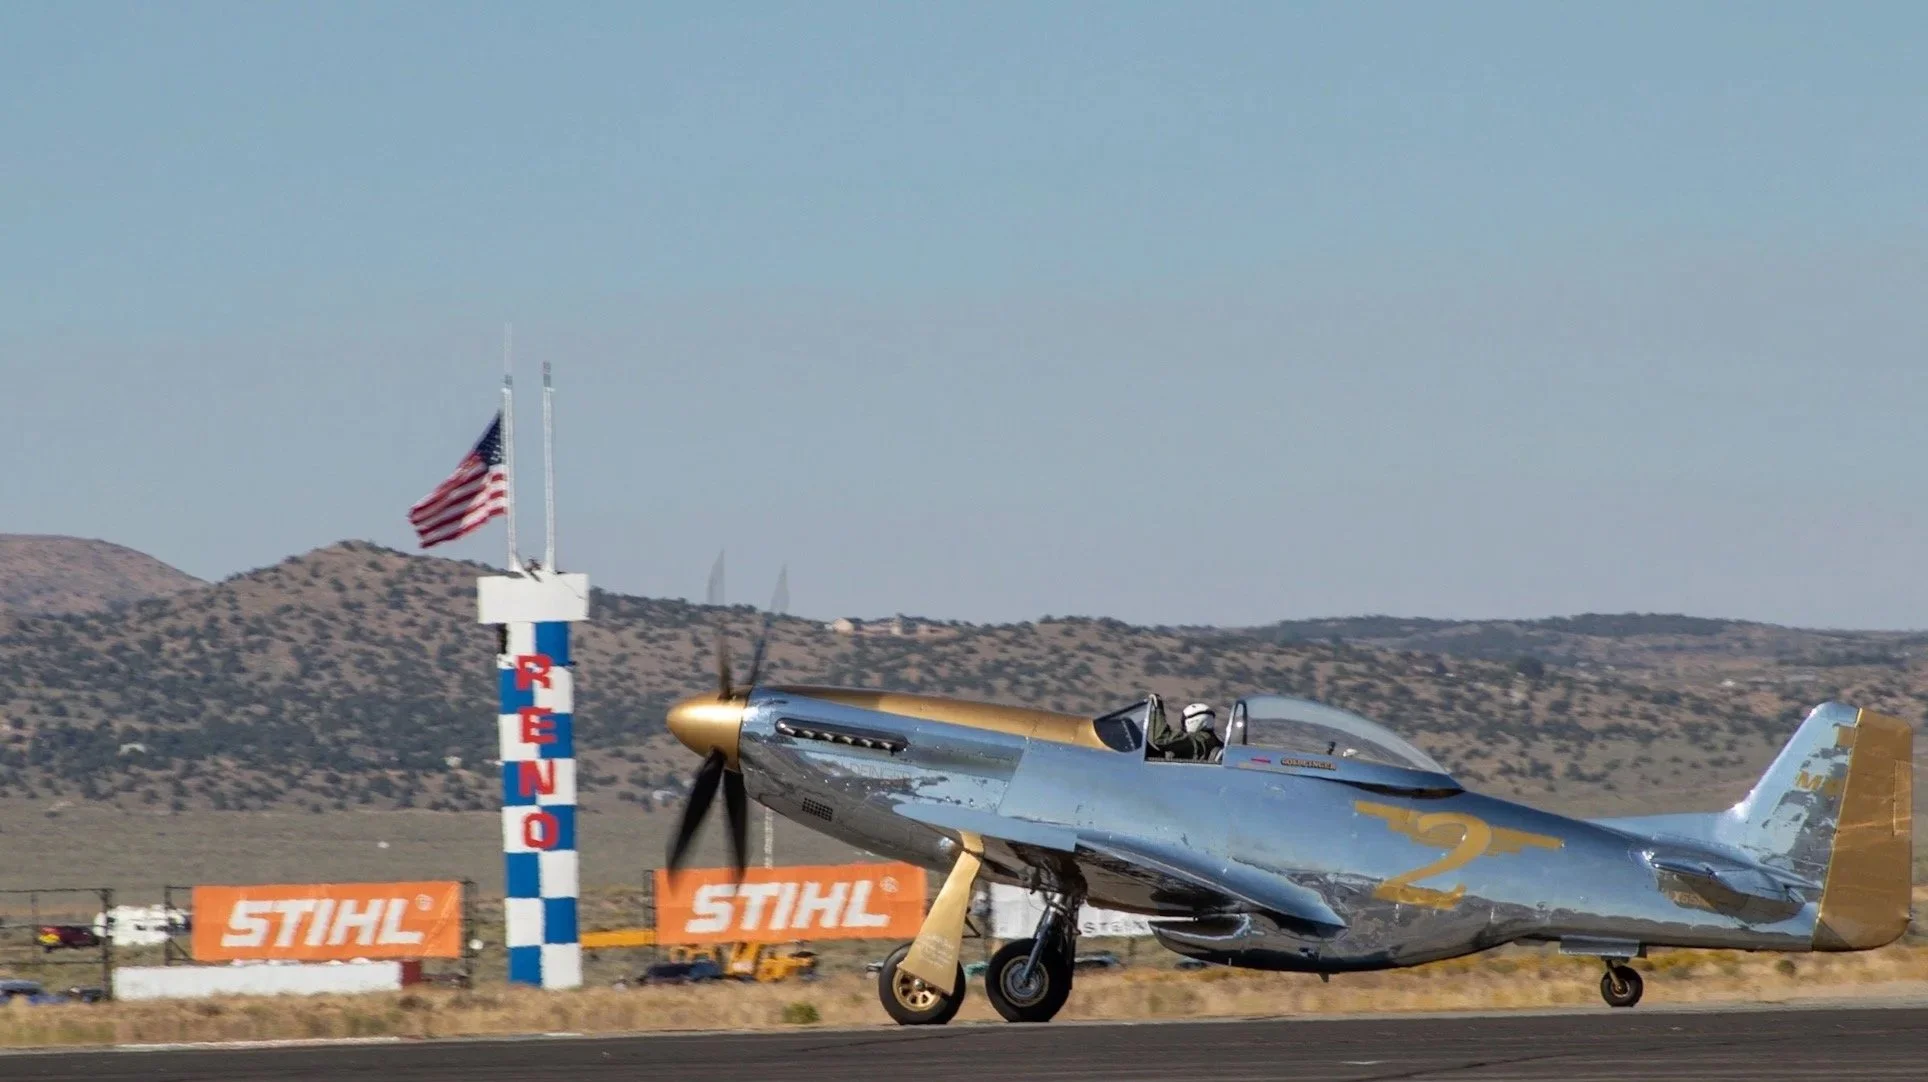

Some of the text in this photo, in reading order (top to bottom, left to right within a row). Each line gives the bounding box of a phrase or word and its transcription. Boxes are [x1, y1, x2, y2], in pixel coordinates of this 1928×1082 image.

[515, 654, 559, 848] RENO
[1374, 812, 1492, 910] 2
[220, 898, 425, 948] STIHL
[684, 880, 891, 934] STIHL
